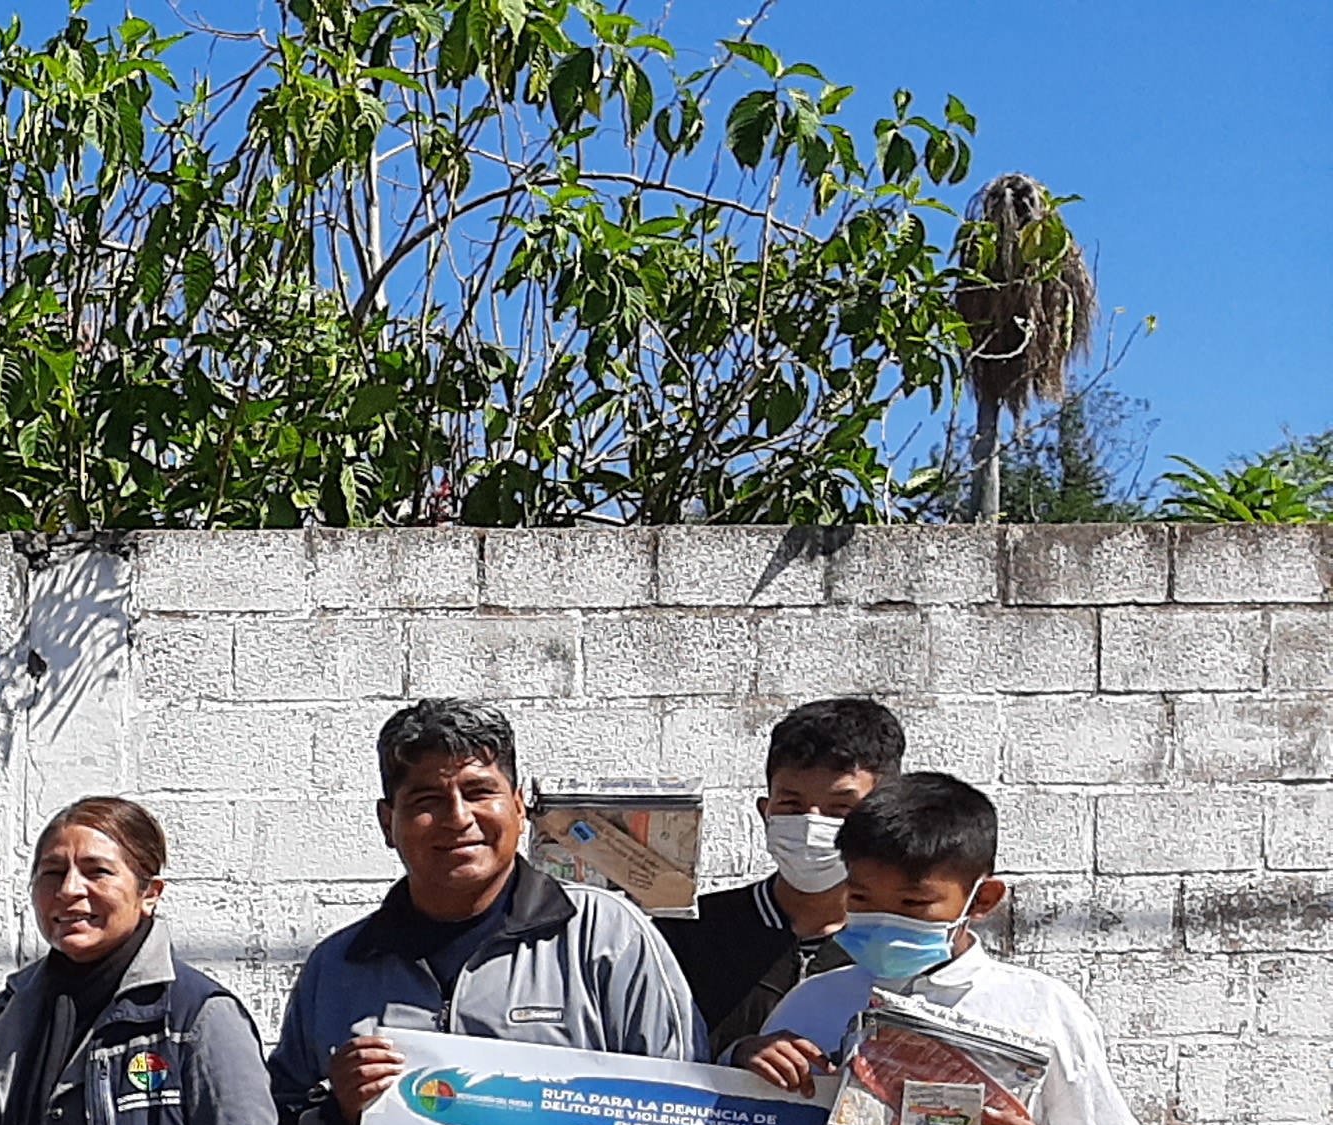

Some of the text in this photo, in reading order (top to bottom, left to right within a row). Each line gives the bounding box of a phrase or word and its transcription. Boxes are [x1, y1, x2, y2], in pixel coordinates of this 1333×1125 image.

[540, 1099, 601, 1116] DELITOS
[603, 1105, 625, 1120] DE
[541, 1087, 778, 1125] RUTA PARA LA DENUNCIA DE
